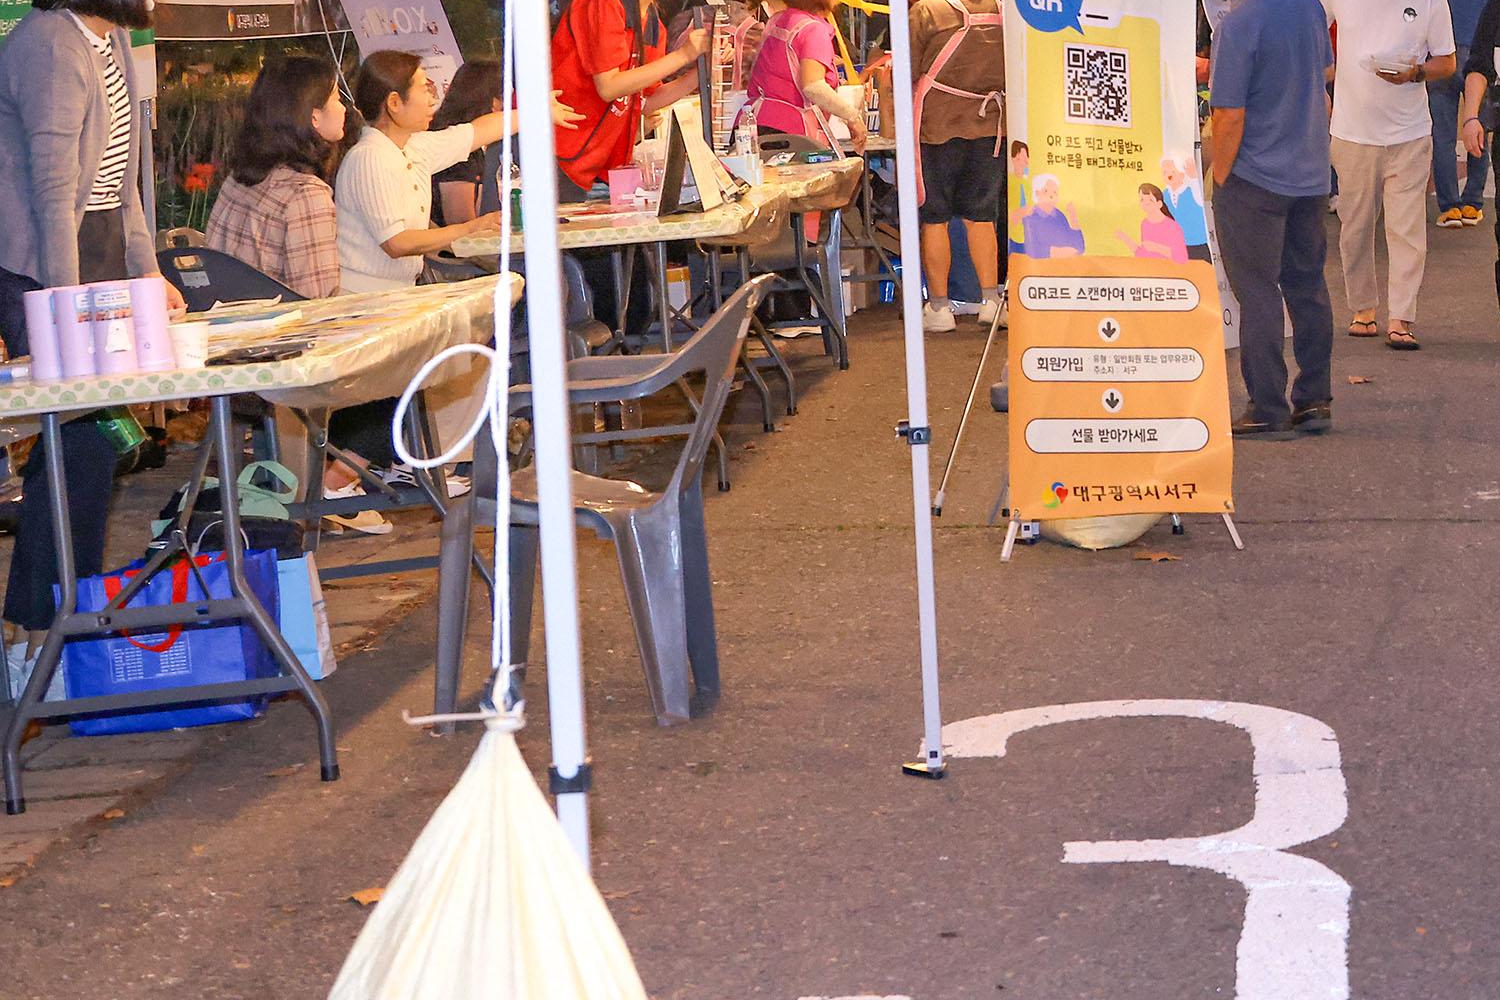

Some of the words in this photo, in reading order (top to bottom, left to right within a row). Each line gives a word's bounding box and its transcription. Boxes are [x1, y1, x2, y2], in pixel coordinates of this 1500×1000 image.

[1065, 136, 1082, 148] 코드
[1085, 137, 1103, 151] 찍고
[1107, 139, 1143, 155] 선물받자
[1047, 151, 1082, 169] 휴대폰을
[1086, 156, 1143, 171] 태그해주세요
[1028, 286, 1071, 300] QR코드
[1076, 286, 1125, 301] 스캔하여
[1129, 286, 1189, 302] 앱다운로드
[1037, 356, 1084, 372] 회원가입
[1113, 354, 1142, 364] 일반회원
[1143, 354, 1158, 364] 또는
[1123, 366, 1137, 375] 서구
[1071, 428, 1094, 444] 선물
[1098, 428, 1159, 444] 받아가세요
[1072, 484, 1162, 503] 대구광역시
[1164, 482, 1199, 501] 서구
